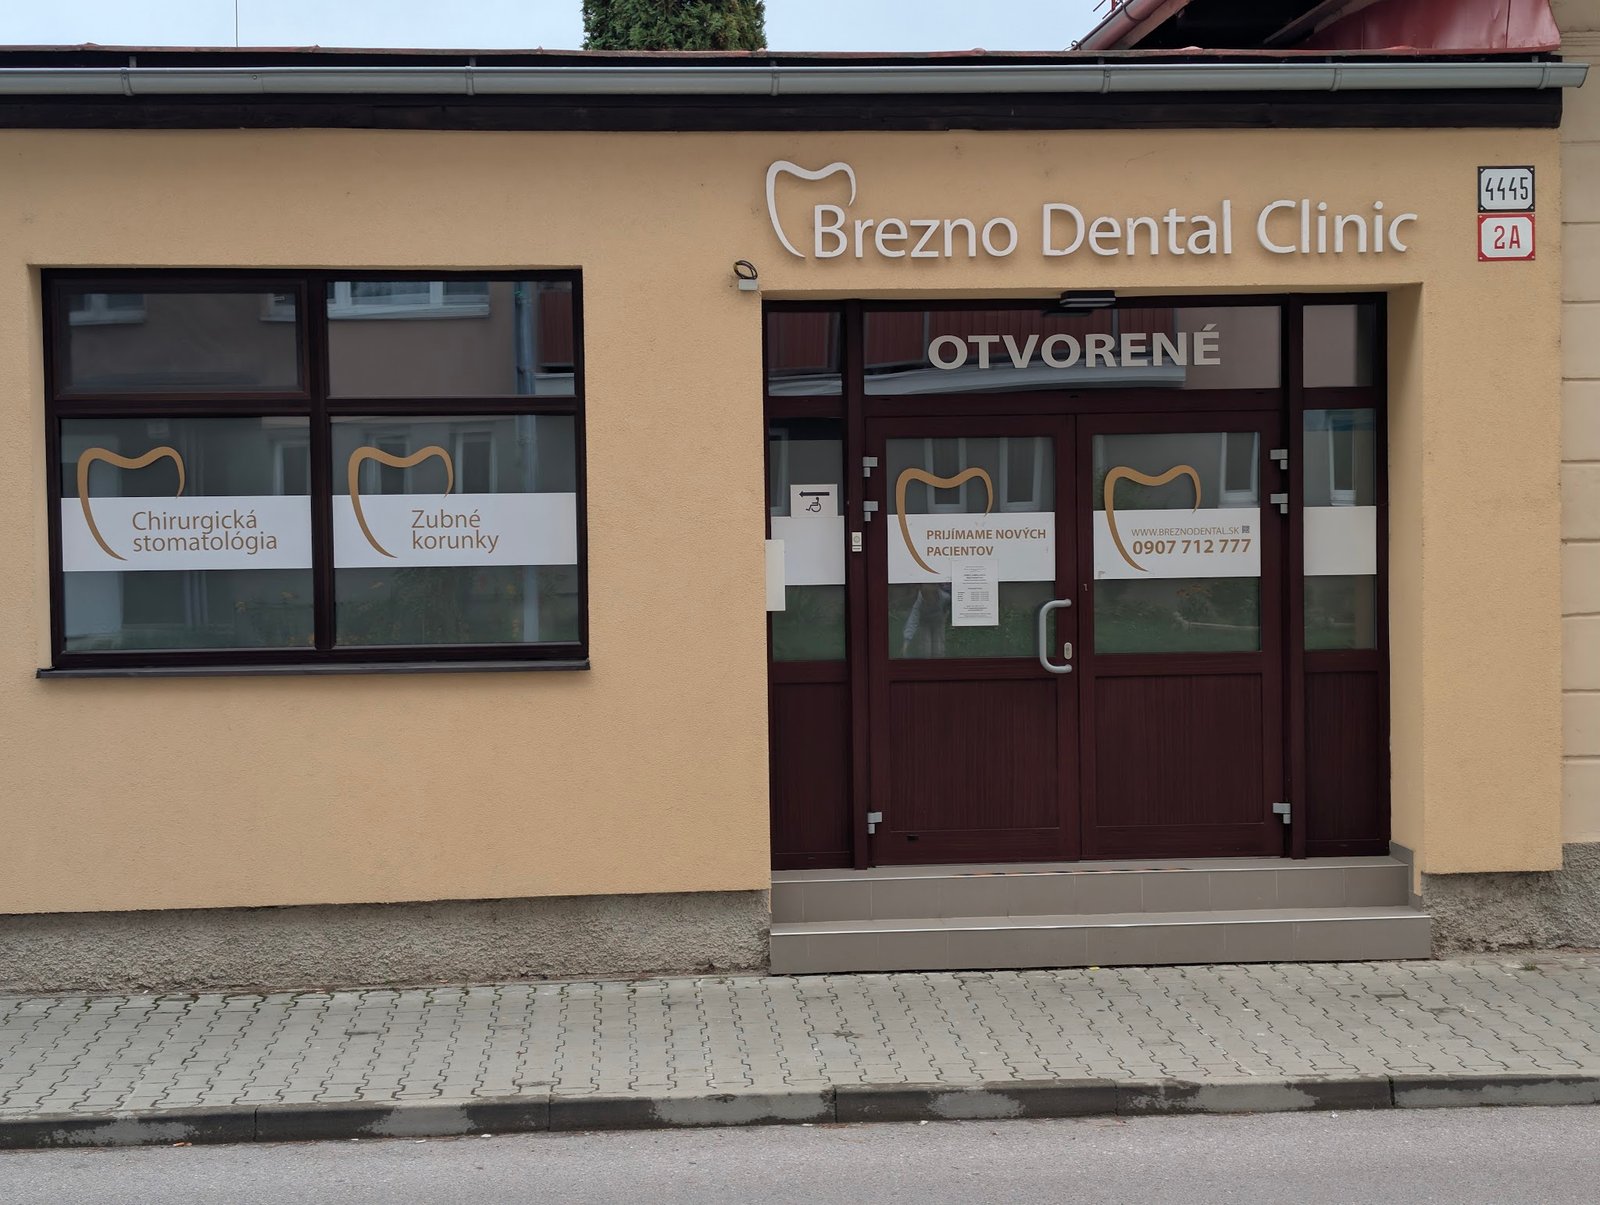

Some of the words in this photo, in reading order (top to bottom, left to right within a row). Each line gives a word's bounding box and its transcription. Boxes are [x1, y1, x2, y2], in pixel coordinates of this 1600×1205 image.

[1485, 177, 1528, 200] 4445
[814, 203, 1018, 259] Brezno
[1042, 198, 1232, 257] Dental
[1256, 198, 1419, 255] Clinic
[1494, 225, 1520, 249] 2A
[928, 323, 1222, 371] OTVORENÉ
[132, 509, 258, 536] Chirurgická
[411, 508, 481, 529] Zubné
[411, 531, 500, 554] korunky
[926, 528, 993, 540] PRIJÍMAME
[995, 527, 1046, 539] NOVÝCH
[1131, 526, 1240, 537] WWW.BREZNODENTAL.SK
[132, 531, 278, 556] stomatológia
[926, 546, 994, 557] PACIENTOV
[1132, 540, 1176, 555] 0907
[1182, 539, 1214, 554] 712
[1218, 538, 1252, 553] 777
